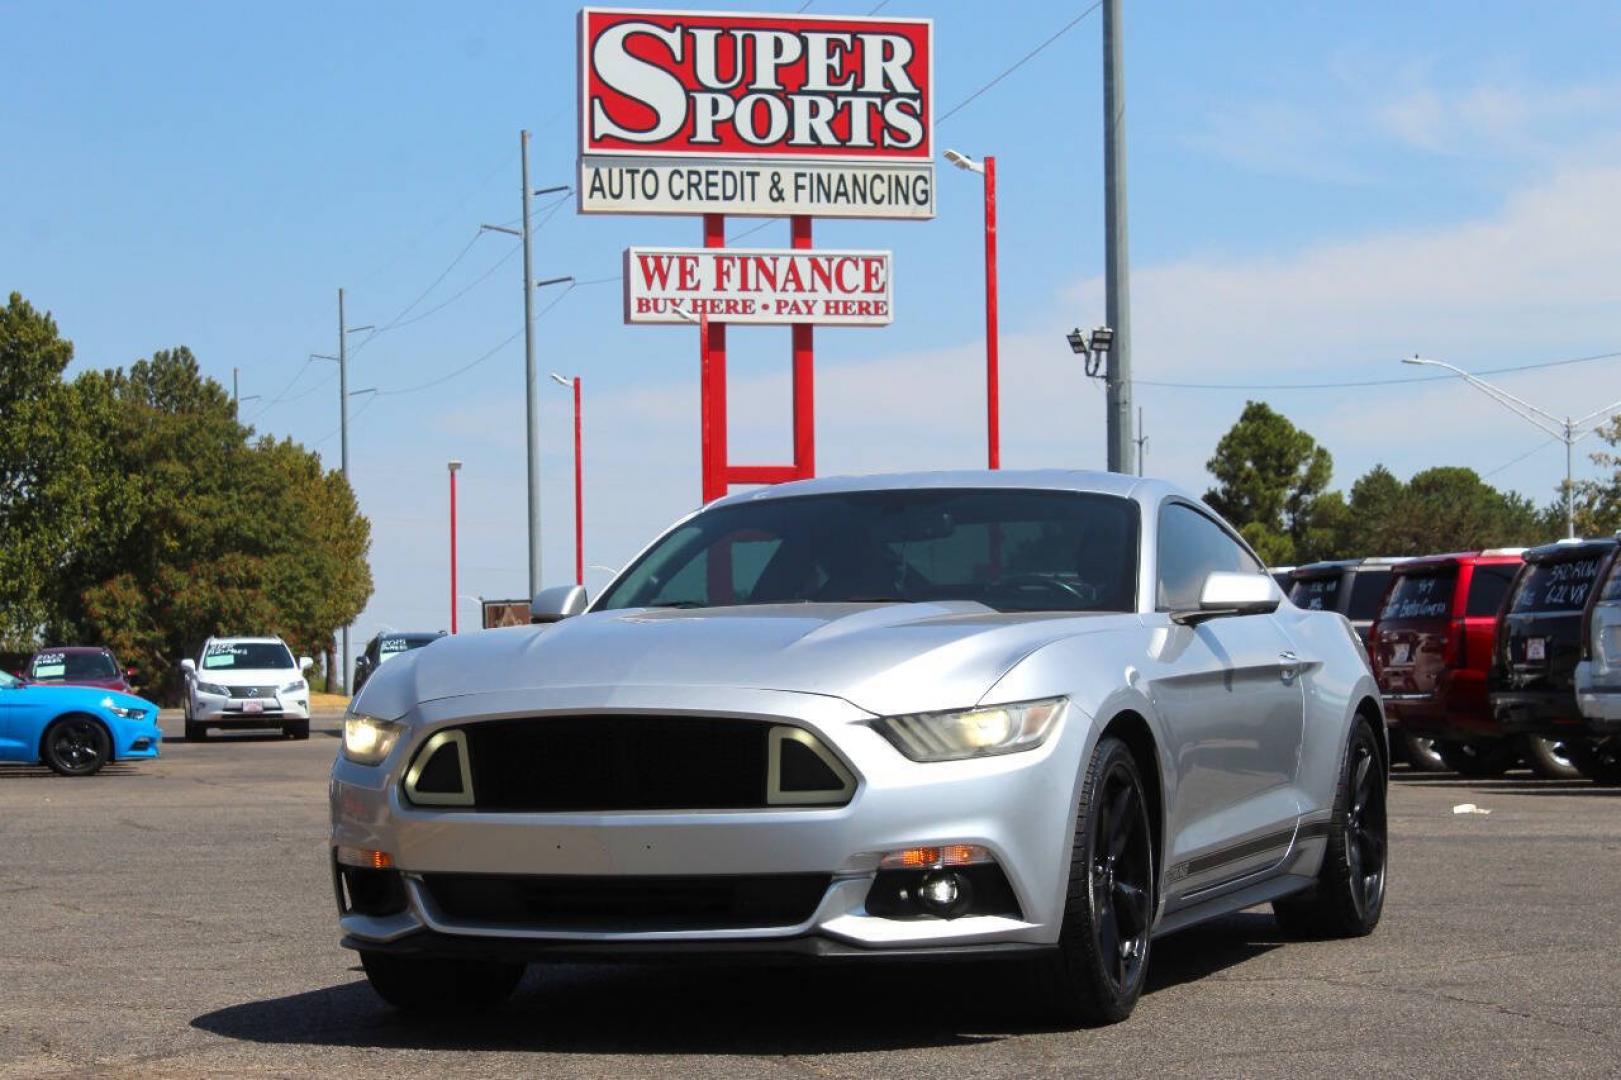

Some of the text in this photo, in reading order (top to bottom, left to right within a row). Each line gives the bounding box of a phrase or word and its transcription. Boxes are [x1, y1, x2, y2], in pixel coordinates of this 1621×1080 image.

[592, 20, 922, 143] SUPER
[588, 167, 930, 206] AUTO CREDIT & FINANCING
[636, 255, 886, 294] WE FINANCE
[636, 297, 889, 317] BUY HERE PAY HERE
